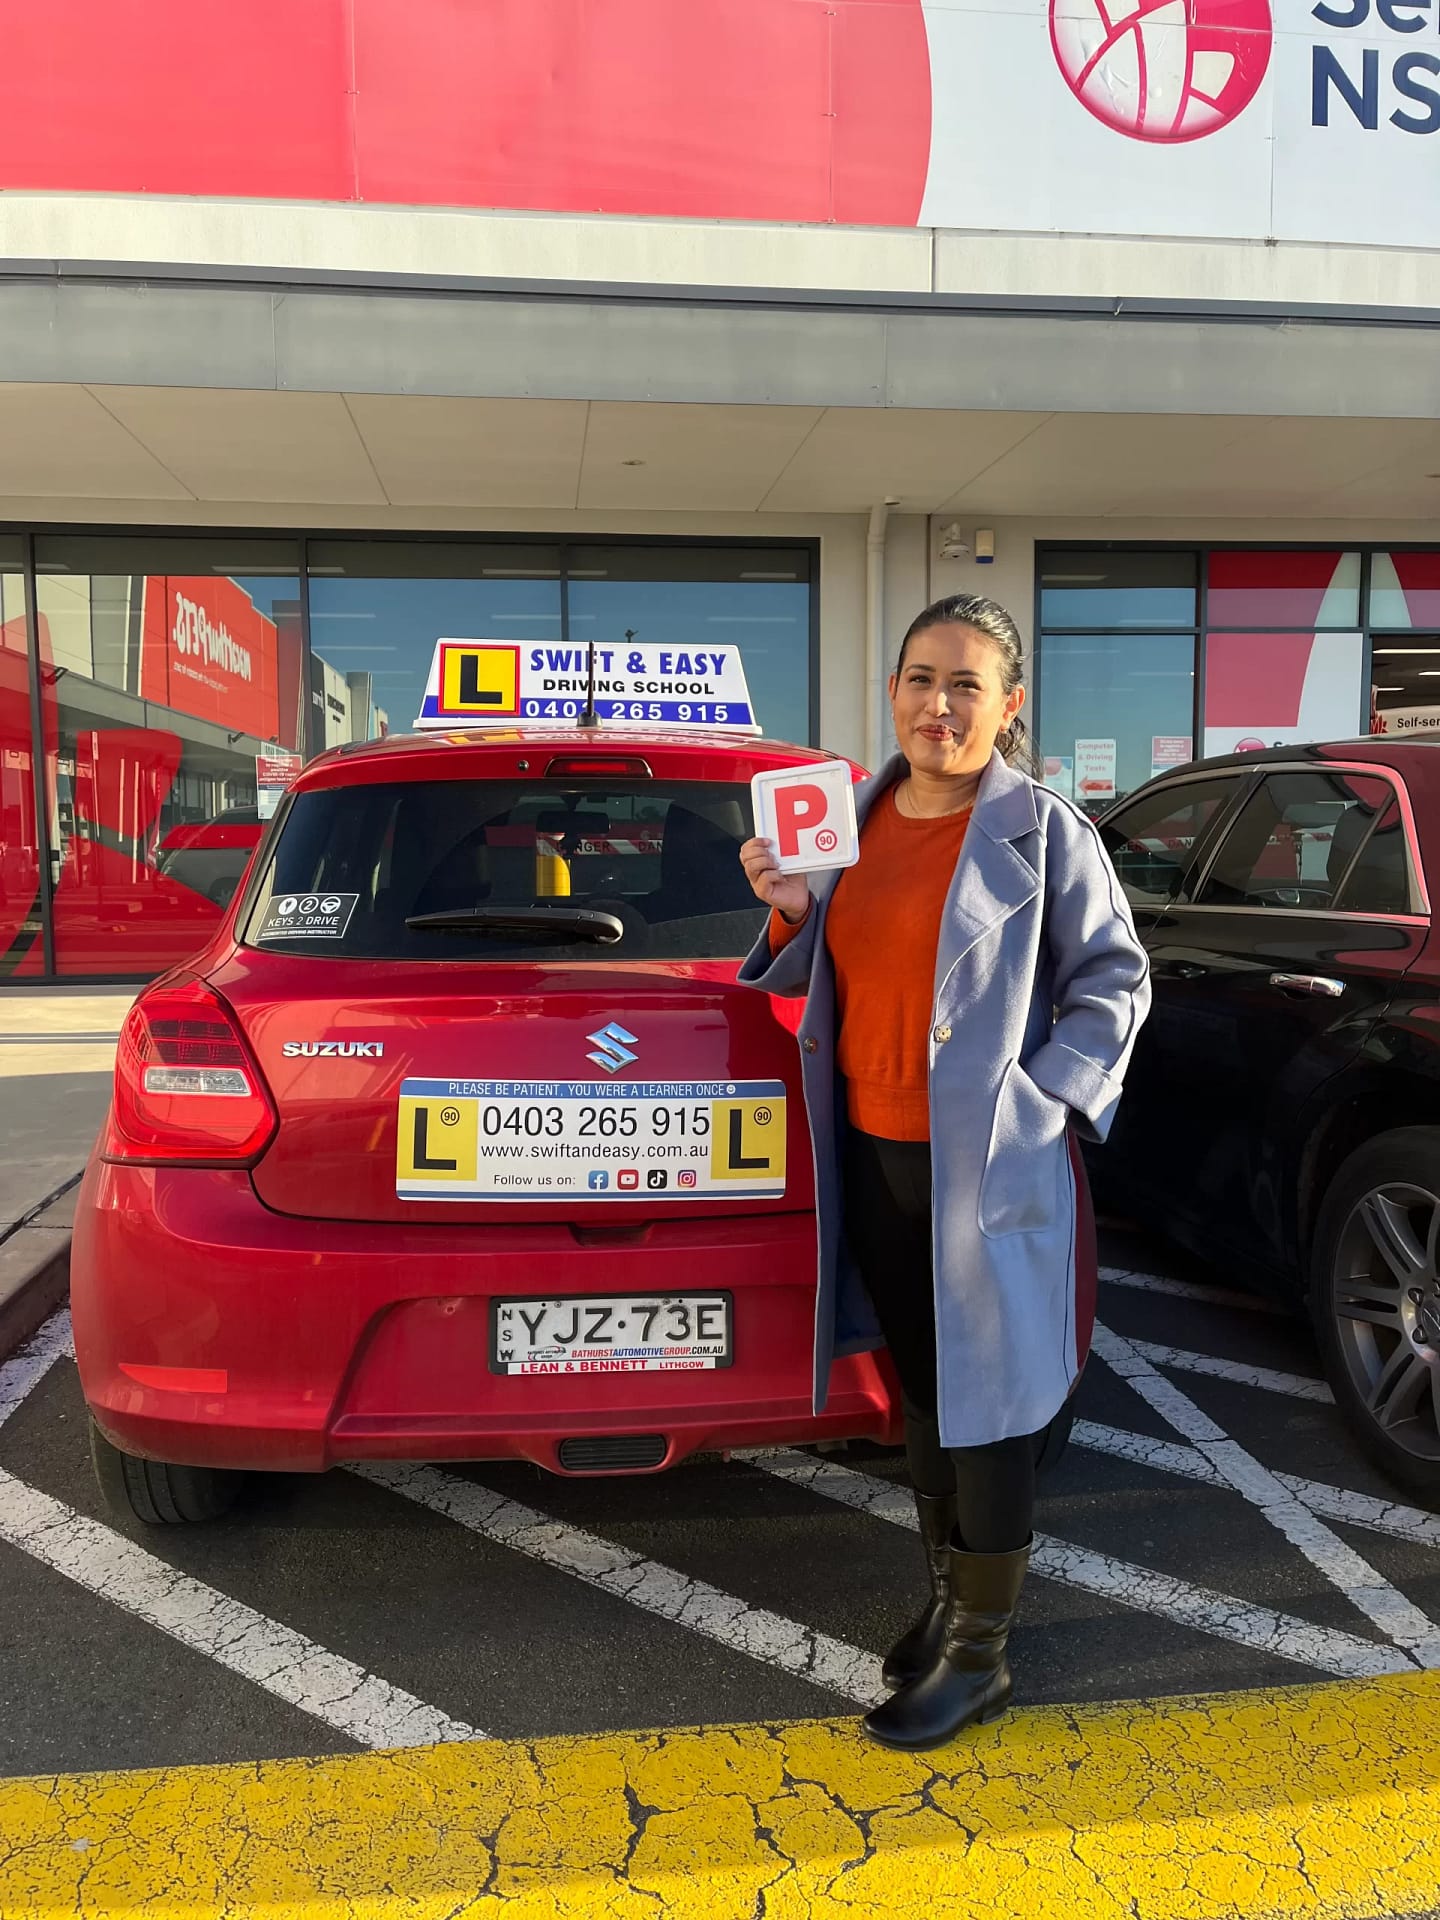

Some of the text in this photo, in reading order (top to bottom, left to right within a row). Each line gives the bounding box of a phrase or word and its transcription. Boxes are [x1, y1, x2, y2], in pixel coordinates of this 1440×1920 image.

[530, 648, 727, 676] SWIFT & EASY
[460, 654, 503, 705] L
[543, 679, 715, 695] DRIVING SCHOOL
[525, 700, 729, 722] 040 265 915
[1076, 743, 1114, 751] Computer
[1086, 753, 1113, 762] Driving
[774, 784, 833, 858] P 90
[267, 916, 340, 928] KEYS 2 DRIVE
[282, 1041, 384, 1057] SUZUKI
[448, 1082, 725, 1098] PLEASE BE PATIENT, YOU WERE A LEARNER ONCE
[482, 1105, 710, 1136] 0403 265 915
[413, 1107, 457, 1171] L 90
[729, 1108, 770, 1169] L 90
[480, 1143, 709, 1160] www.swiftandeasy.com.au
[493, 1174, 576, 1186] Follow us on:
[571, 1345, 724, 1359] BATHURSTAUTOMOTIVEGROUP.COM.AU
[520, 1360, 705, 1374] LEAN & BENNETT LITHGOW
